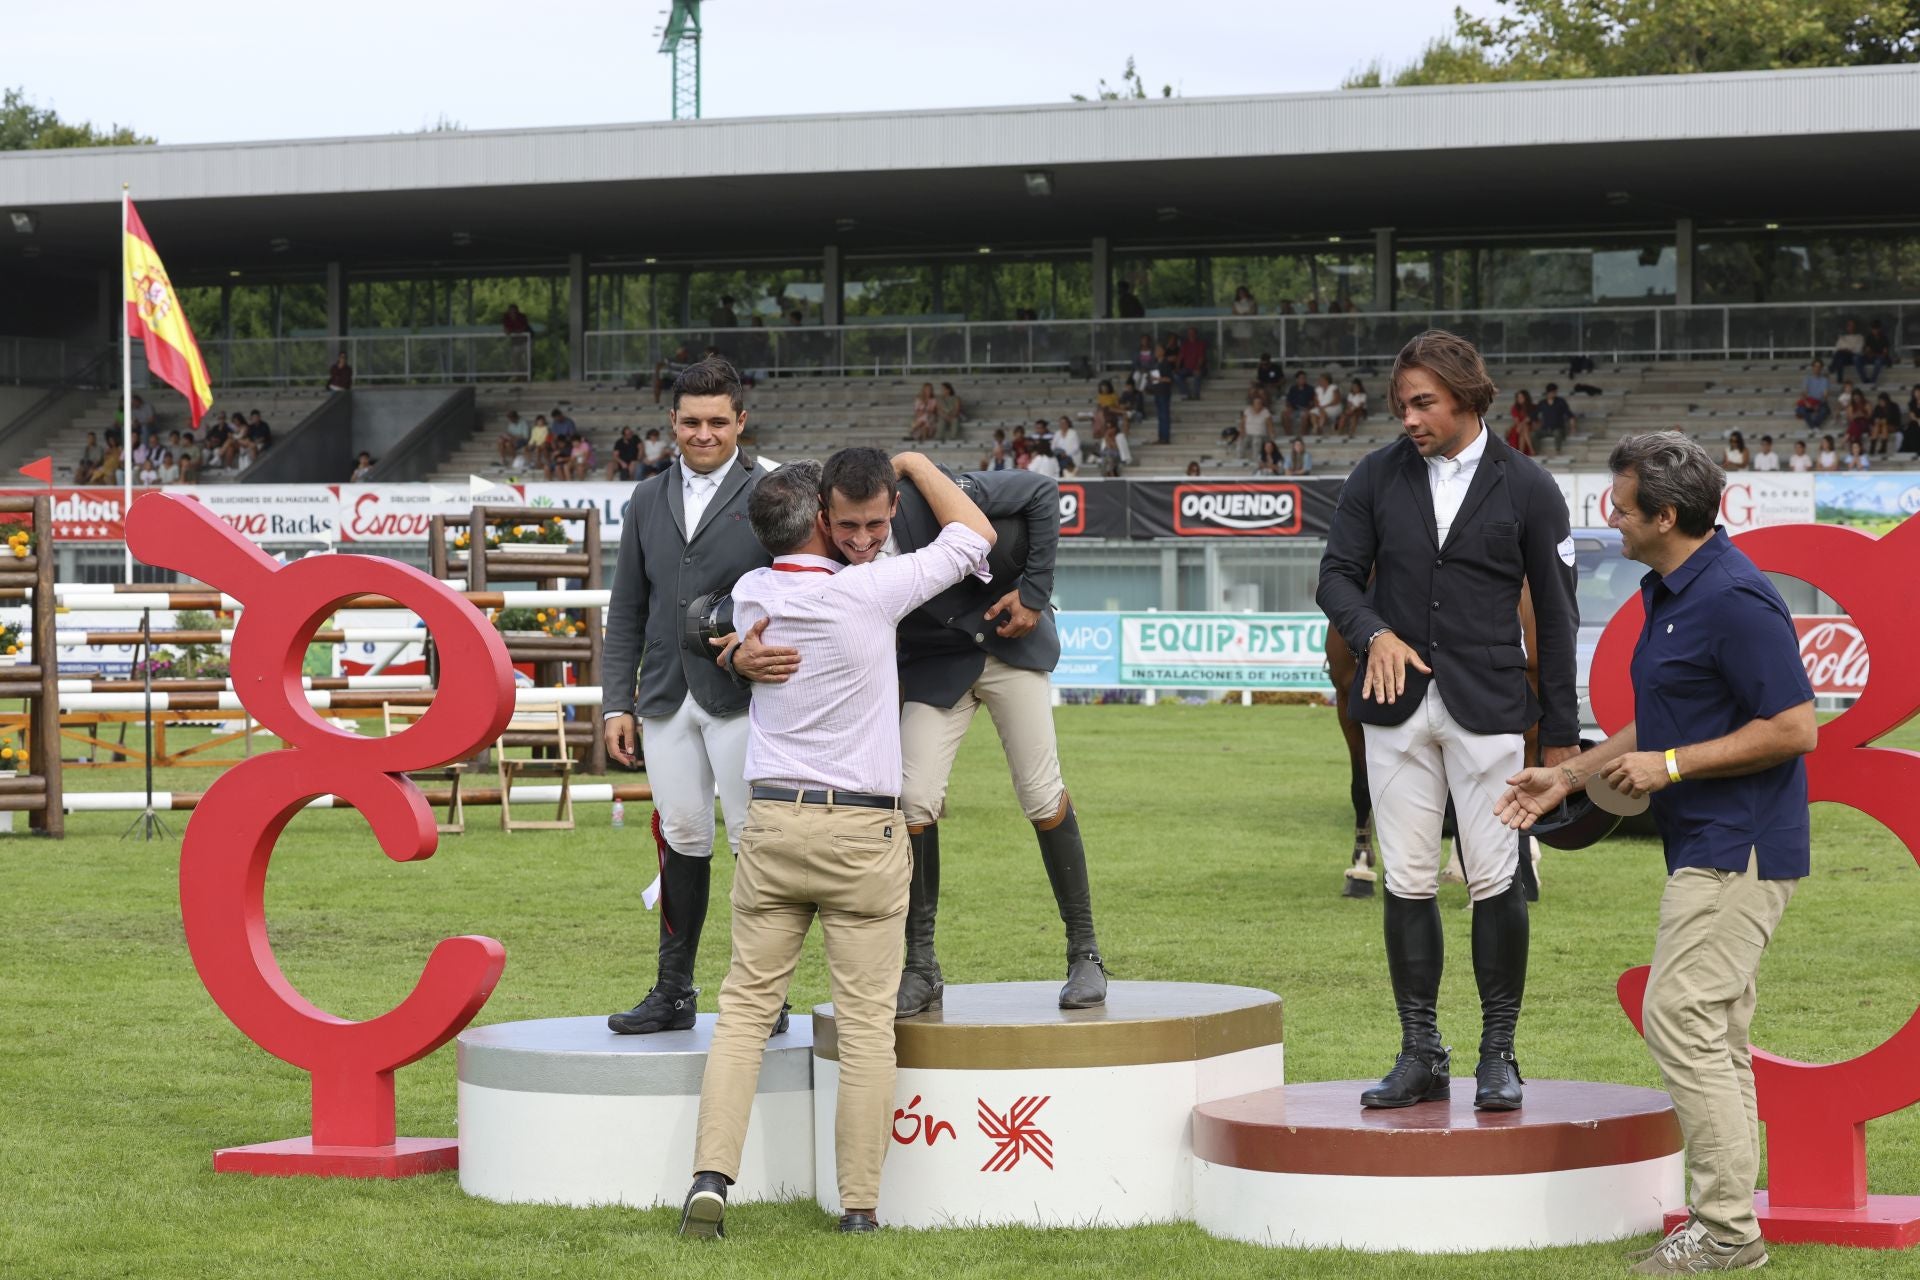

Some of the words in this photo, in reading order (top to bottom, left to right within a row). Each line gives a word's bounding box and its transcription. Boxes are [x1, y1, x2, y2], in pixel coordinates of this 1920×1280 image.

[210, 496, 261, 504] SOLUCIONES
[262, 496, 273, 504] DE
[276, 496, 329, 504] ALMACENAJE
[1181, 494, 1293, 519] OQUENDO
[271, 514, 332, 534] Racks
[1132, 670, 1243, 680] INSTALACIONES
[1248, 670, 1265, 681] DE
